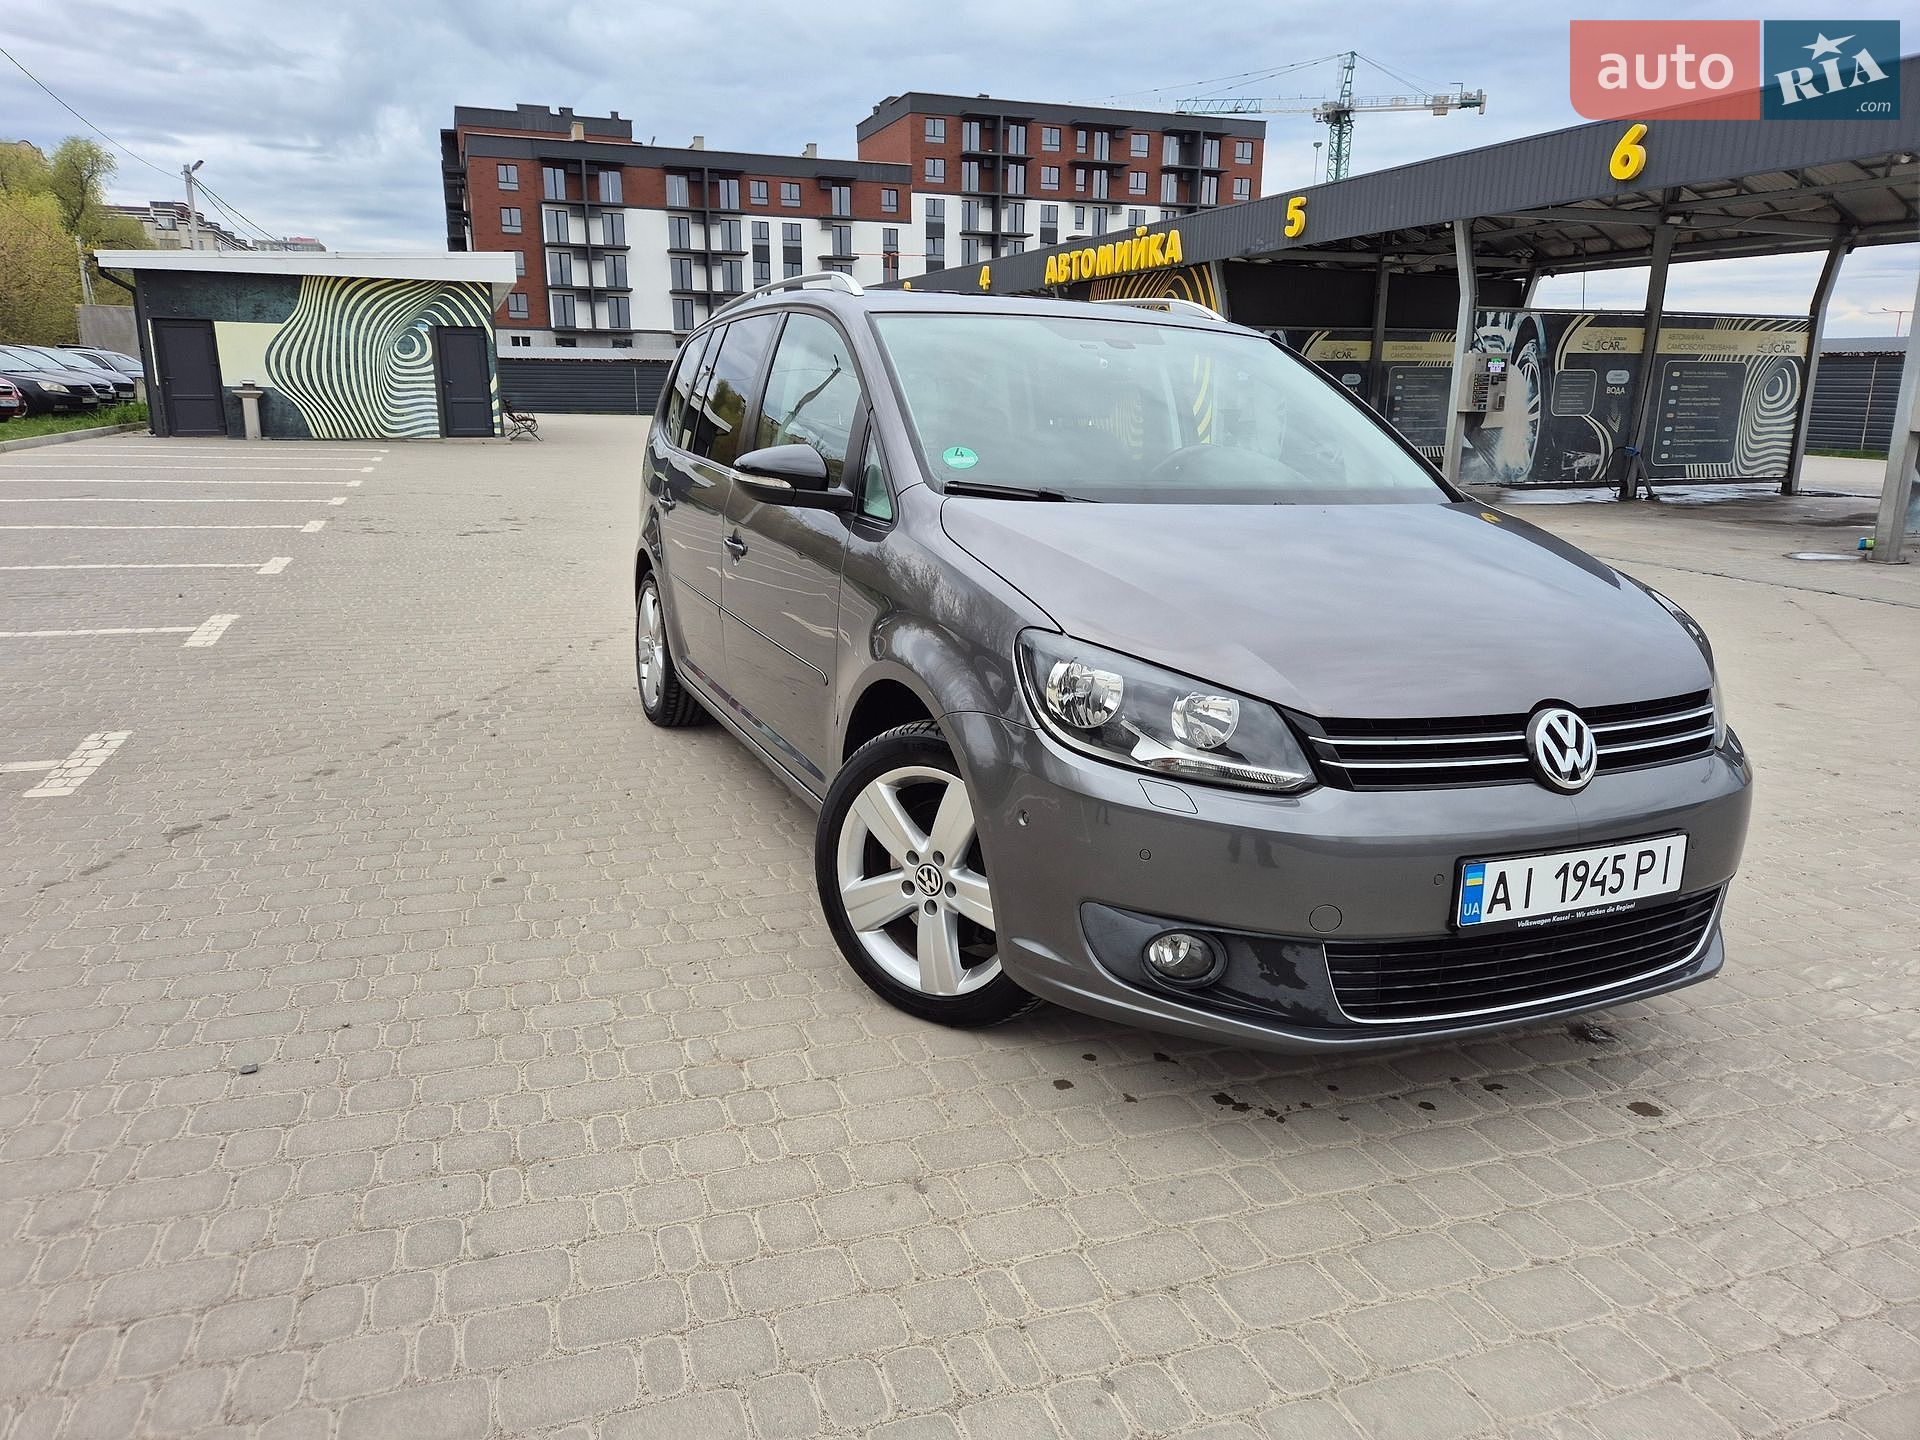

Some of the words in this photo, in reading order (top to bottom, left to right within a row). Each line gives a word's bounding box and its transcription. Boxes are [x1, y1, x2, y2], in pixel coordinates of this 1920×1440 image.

[1609, 123, 1648, 181] 6
[1285, 196, 1307, 238] 5
[1044, 226, 1183, 285] АВТОМИЙКА
[979, 265, 991, 290] 4
[1487, 867, 1533, 914] AI
[1554, 853, 1626, 903] 1945
[1633, 845, 1672, 891] PI
[1464, 901, 1481, 917] UA
[1517, 917, 1551, 928] Volkswagen
[1552, 913, 1571, 922] Kassel
[1576, 911, 1586, 919] Wir
[1607, 906, 1615, 914] die
[1616, 902, 1636, 912] Region!
